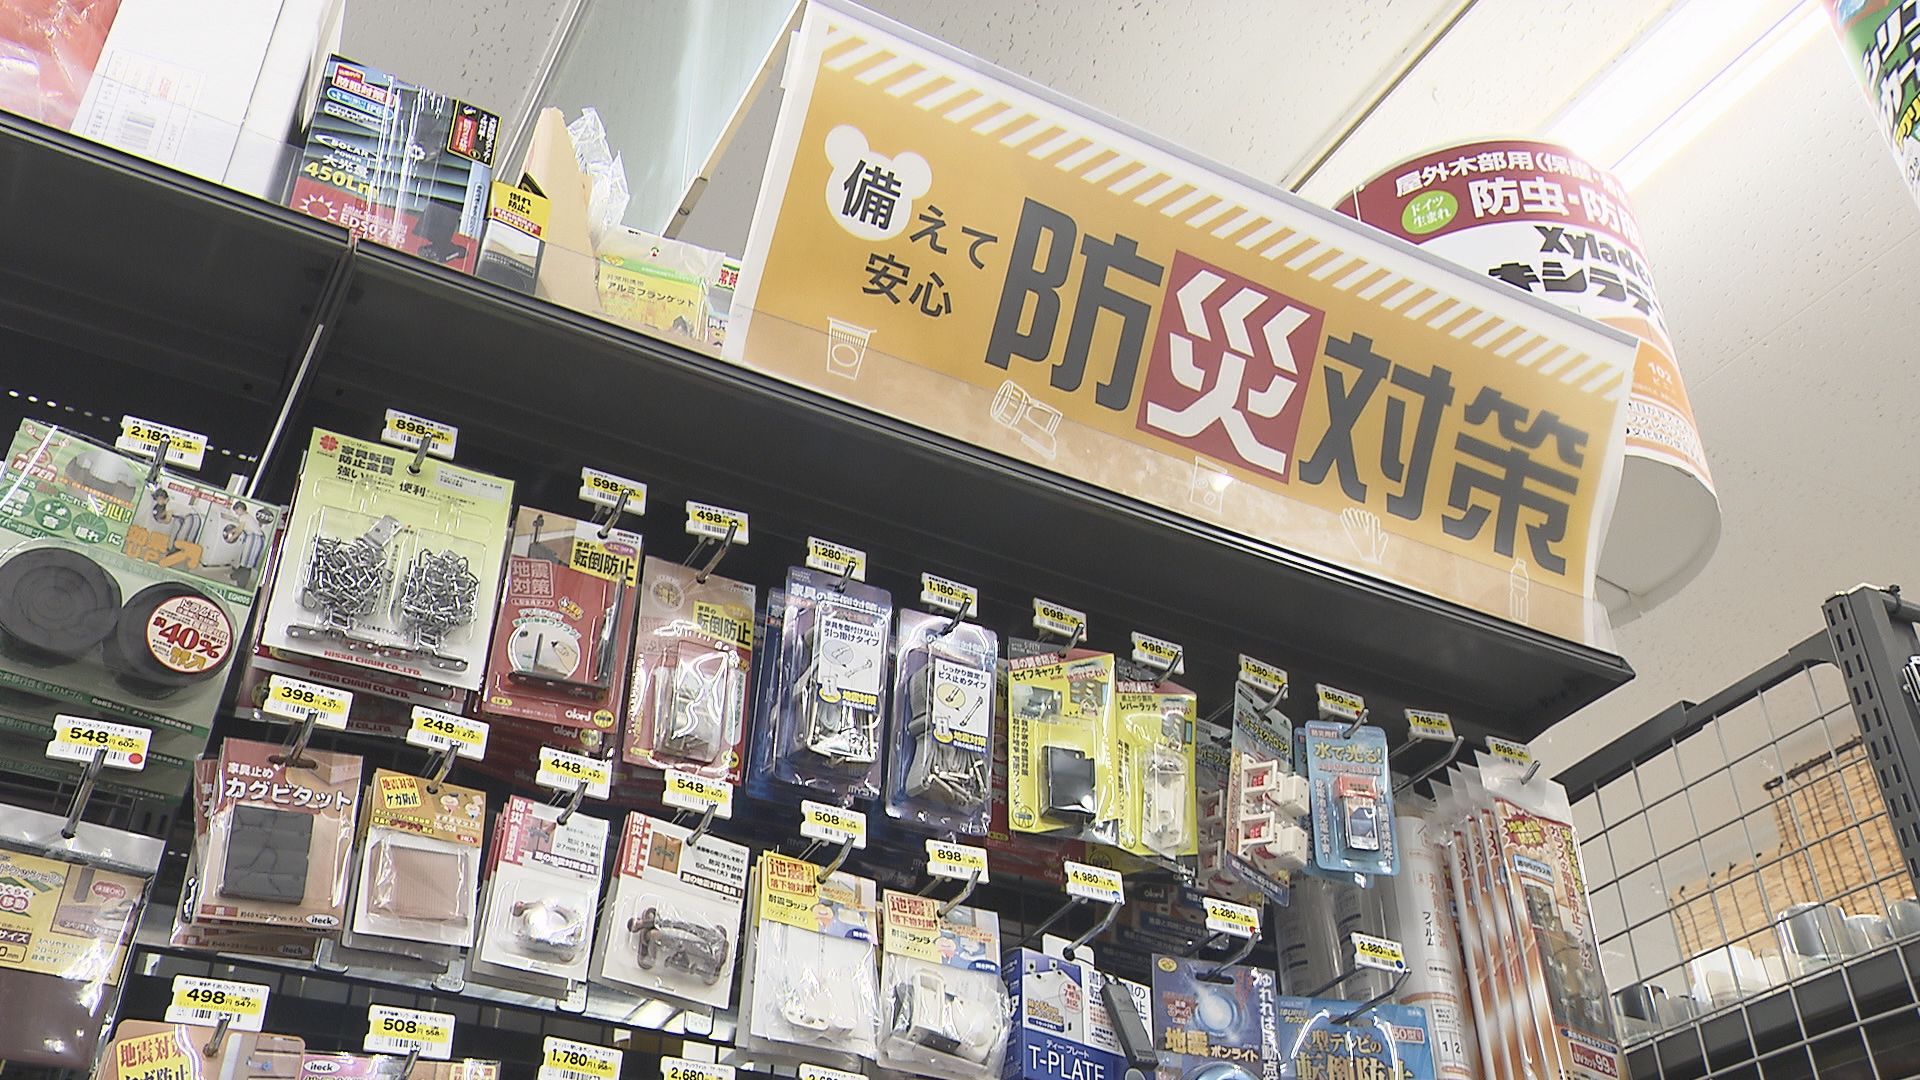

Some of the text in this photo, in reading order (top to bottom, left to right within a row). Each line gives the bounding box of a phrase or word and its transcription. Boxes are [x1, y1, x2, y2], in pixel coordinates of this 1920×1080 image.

[841, 159, 999, 270] 備えて
[862, 252, 954, 319] 安心
[984, 196, 1590, 577] 防災対策
[400, 481, 427, 498] 便利
[573, 548, 635, 582] 転倒防止
[1313, 742, 1384, 764] 水で光る!
[225, 777, 352, 811] カグビタット
[769, 859, 804, 881] 地震
[890, 895, 925, 917] 地震
